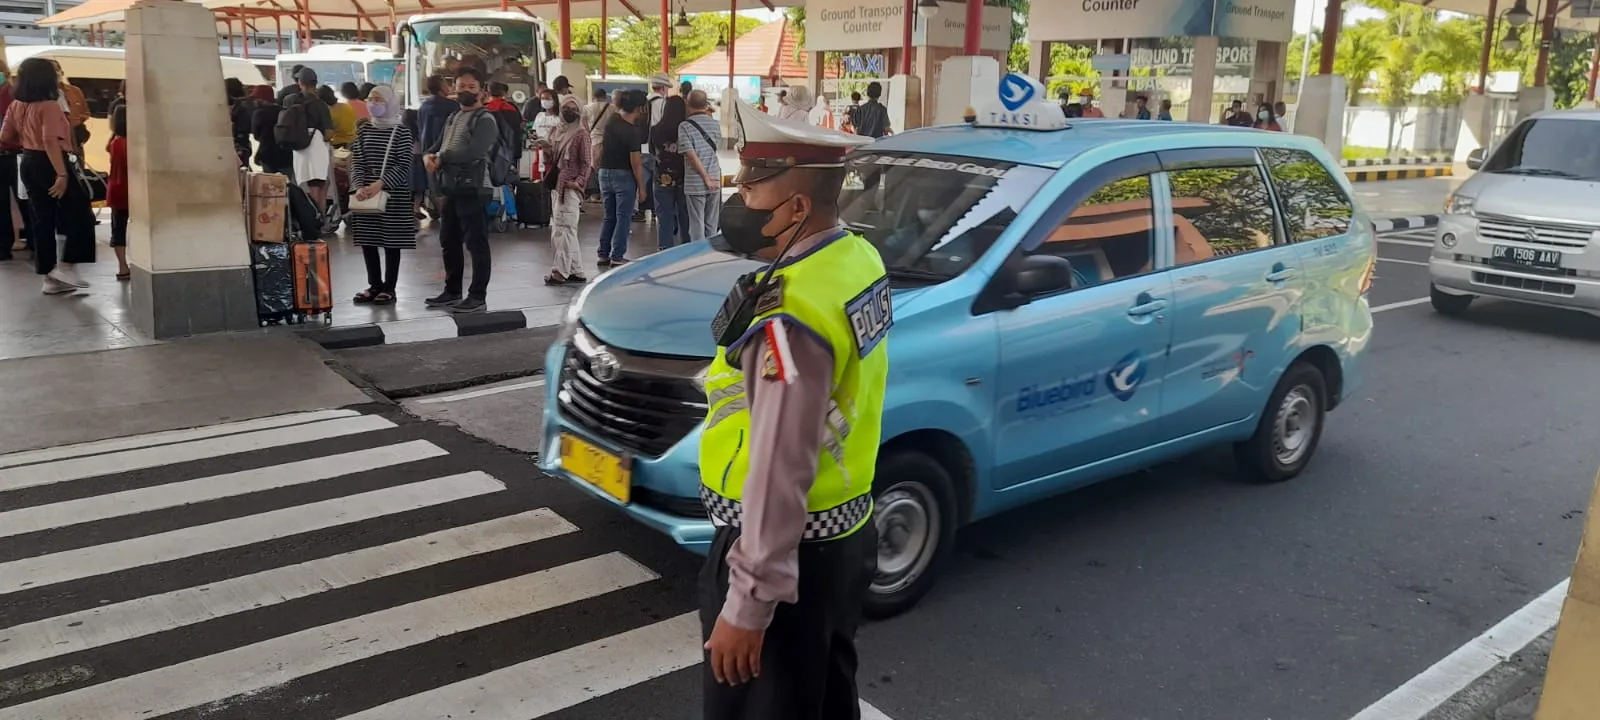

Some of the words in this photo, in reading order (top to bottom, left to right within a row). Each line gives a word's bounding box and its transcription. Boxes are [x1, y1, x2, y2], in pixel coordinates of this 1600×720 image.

[820, 7, 856, 21] Ground
[859, 5, 904, 18] Transpor
[1082, 0, 1138, 12] Counter
[1225, 2, 1253, 16] Ground
[1254, 5, 1286, 21] Transport
[842, 21, 883, 33] Counter
[944, 19, 966, 29] Groun
[844, 55, 884, 72] TAXI
[1131, 48, 1179, 64] GROUND
[989, 112, 1038, 125] TAKSI
[1494, 245, 1508, 257] DK
[1513, 248, 1535, 260] 1506
[1540, 251, 1559, 264] AAV
[850, 285, 890, 350] POLISI
[1016, 375, 1096, 412] Bluebird
